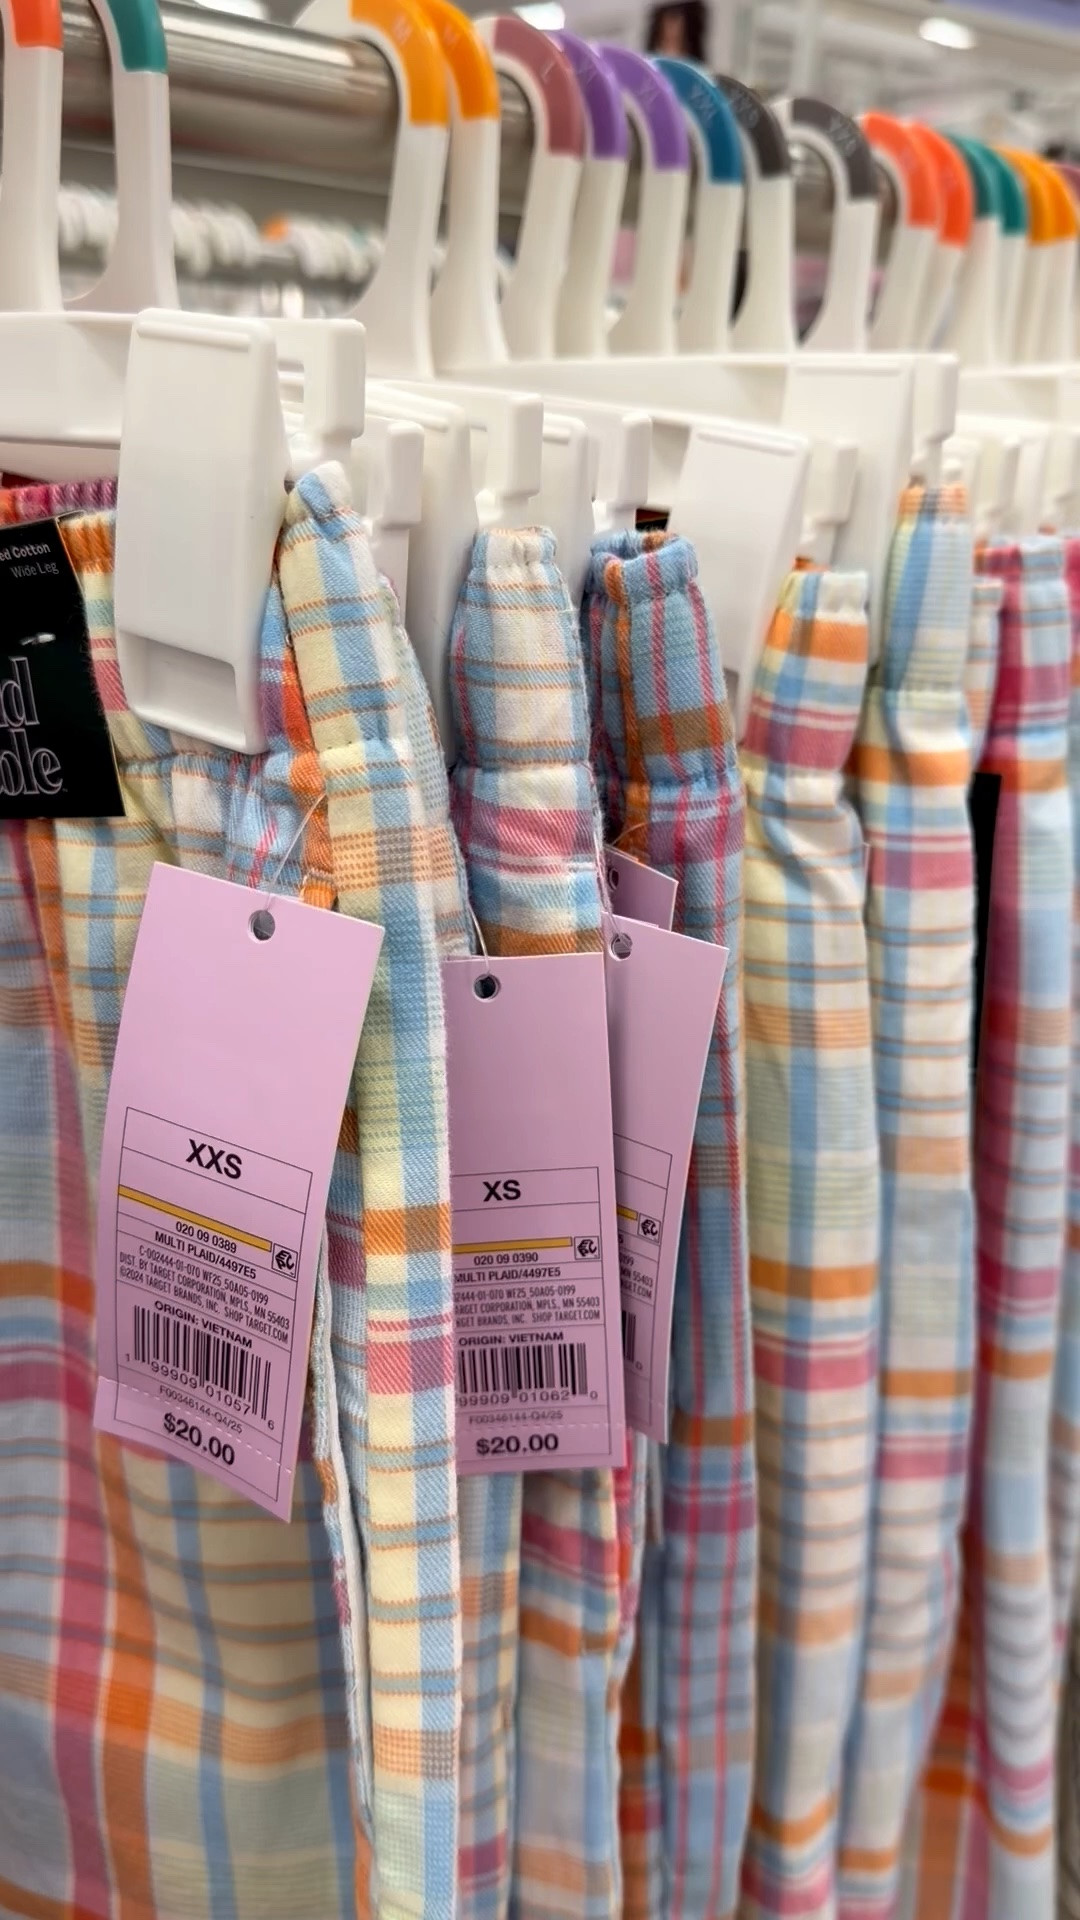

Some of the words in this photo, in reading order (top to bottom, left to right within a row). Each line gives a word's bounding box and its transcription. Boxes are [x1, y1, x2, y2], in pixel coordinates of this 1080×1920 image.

[11, 543, 51, 559] Cotton
[10, 564, 37, 578] Wide
[36, 561, 59, 575] Leg
[0, 656, 40, 727] d
[185, 1138, 242, 1180] XXS
[483, 1179, 521, 1202] XS
[175, 1220, 195, 1237] 020
[197, 1229, 210, 1243] 09
[212, 1235, 237, 1253] 0389
[139, 1244, 201, 1278] C-002444-01-070
[155, 1230, 186, 1251] MULTI
[188, 1244, 257, 1280] PLAID/4497E5
[474, 1255, 494, 1266] 020
[496, 1253, 510, 1265] 09
[512, 1252, 539, 1264] 0390
[454, 1271, 485, 1284] MULTI
[488, 1267, 561, 1281] PLAID/4497E5
[120, 1251, 138, 1268] DIST.
[139, 1258, 148, 1271] BY
[150, 1262, 175, 1281] TARGET
[177, 1273, 228, 1305] CORPORATION,
[254, 1304, 267, 1319] MN
[267, 1310, 290, 1330] 55403
[562, 1297, 575, 1308] MN
[576, 1296, 600, 1307] 55403
[145, 1274, 171, 1294] TARGET
[173, 1285, 205, 1308] BRANDS,
[206, 1298, 221, 1313] INC.
[224, 1306, 244, 1323] SHOP
[245, 1314, 289, 1344] TARGET.COM
[532, 1312, 553, 1323] SHOP
[555, 1309, 600, 1321] TARGET.COM
[154, 1300, 200, 1325] ORIGIN:
[201, 1318, 253, 1349] VIETNAM
[458, 1335, 506, 1347] ORIGIN:
[508, 1332, 564, 1343] VIETNAM
[151, 1361, 198, 1390] 99909
[205, 1384, 252, 1416] 01057
[267, 1419, 275, 1431] 6
[519, 1390, 571, 1403] 01062
[590, 1391, 598, 1399] 0
[163, 1412, 236, 1466] $20.00
[476, 1433, 560, 1457] $20.00
